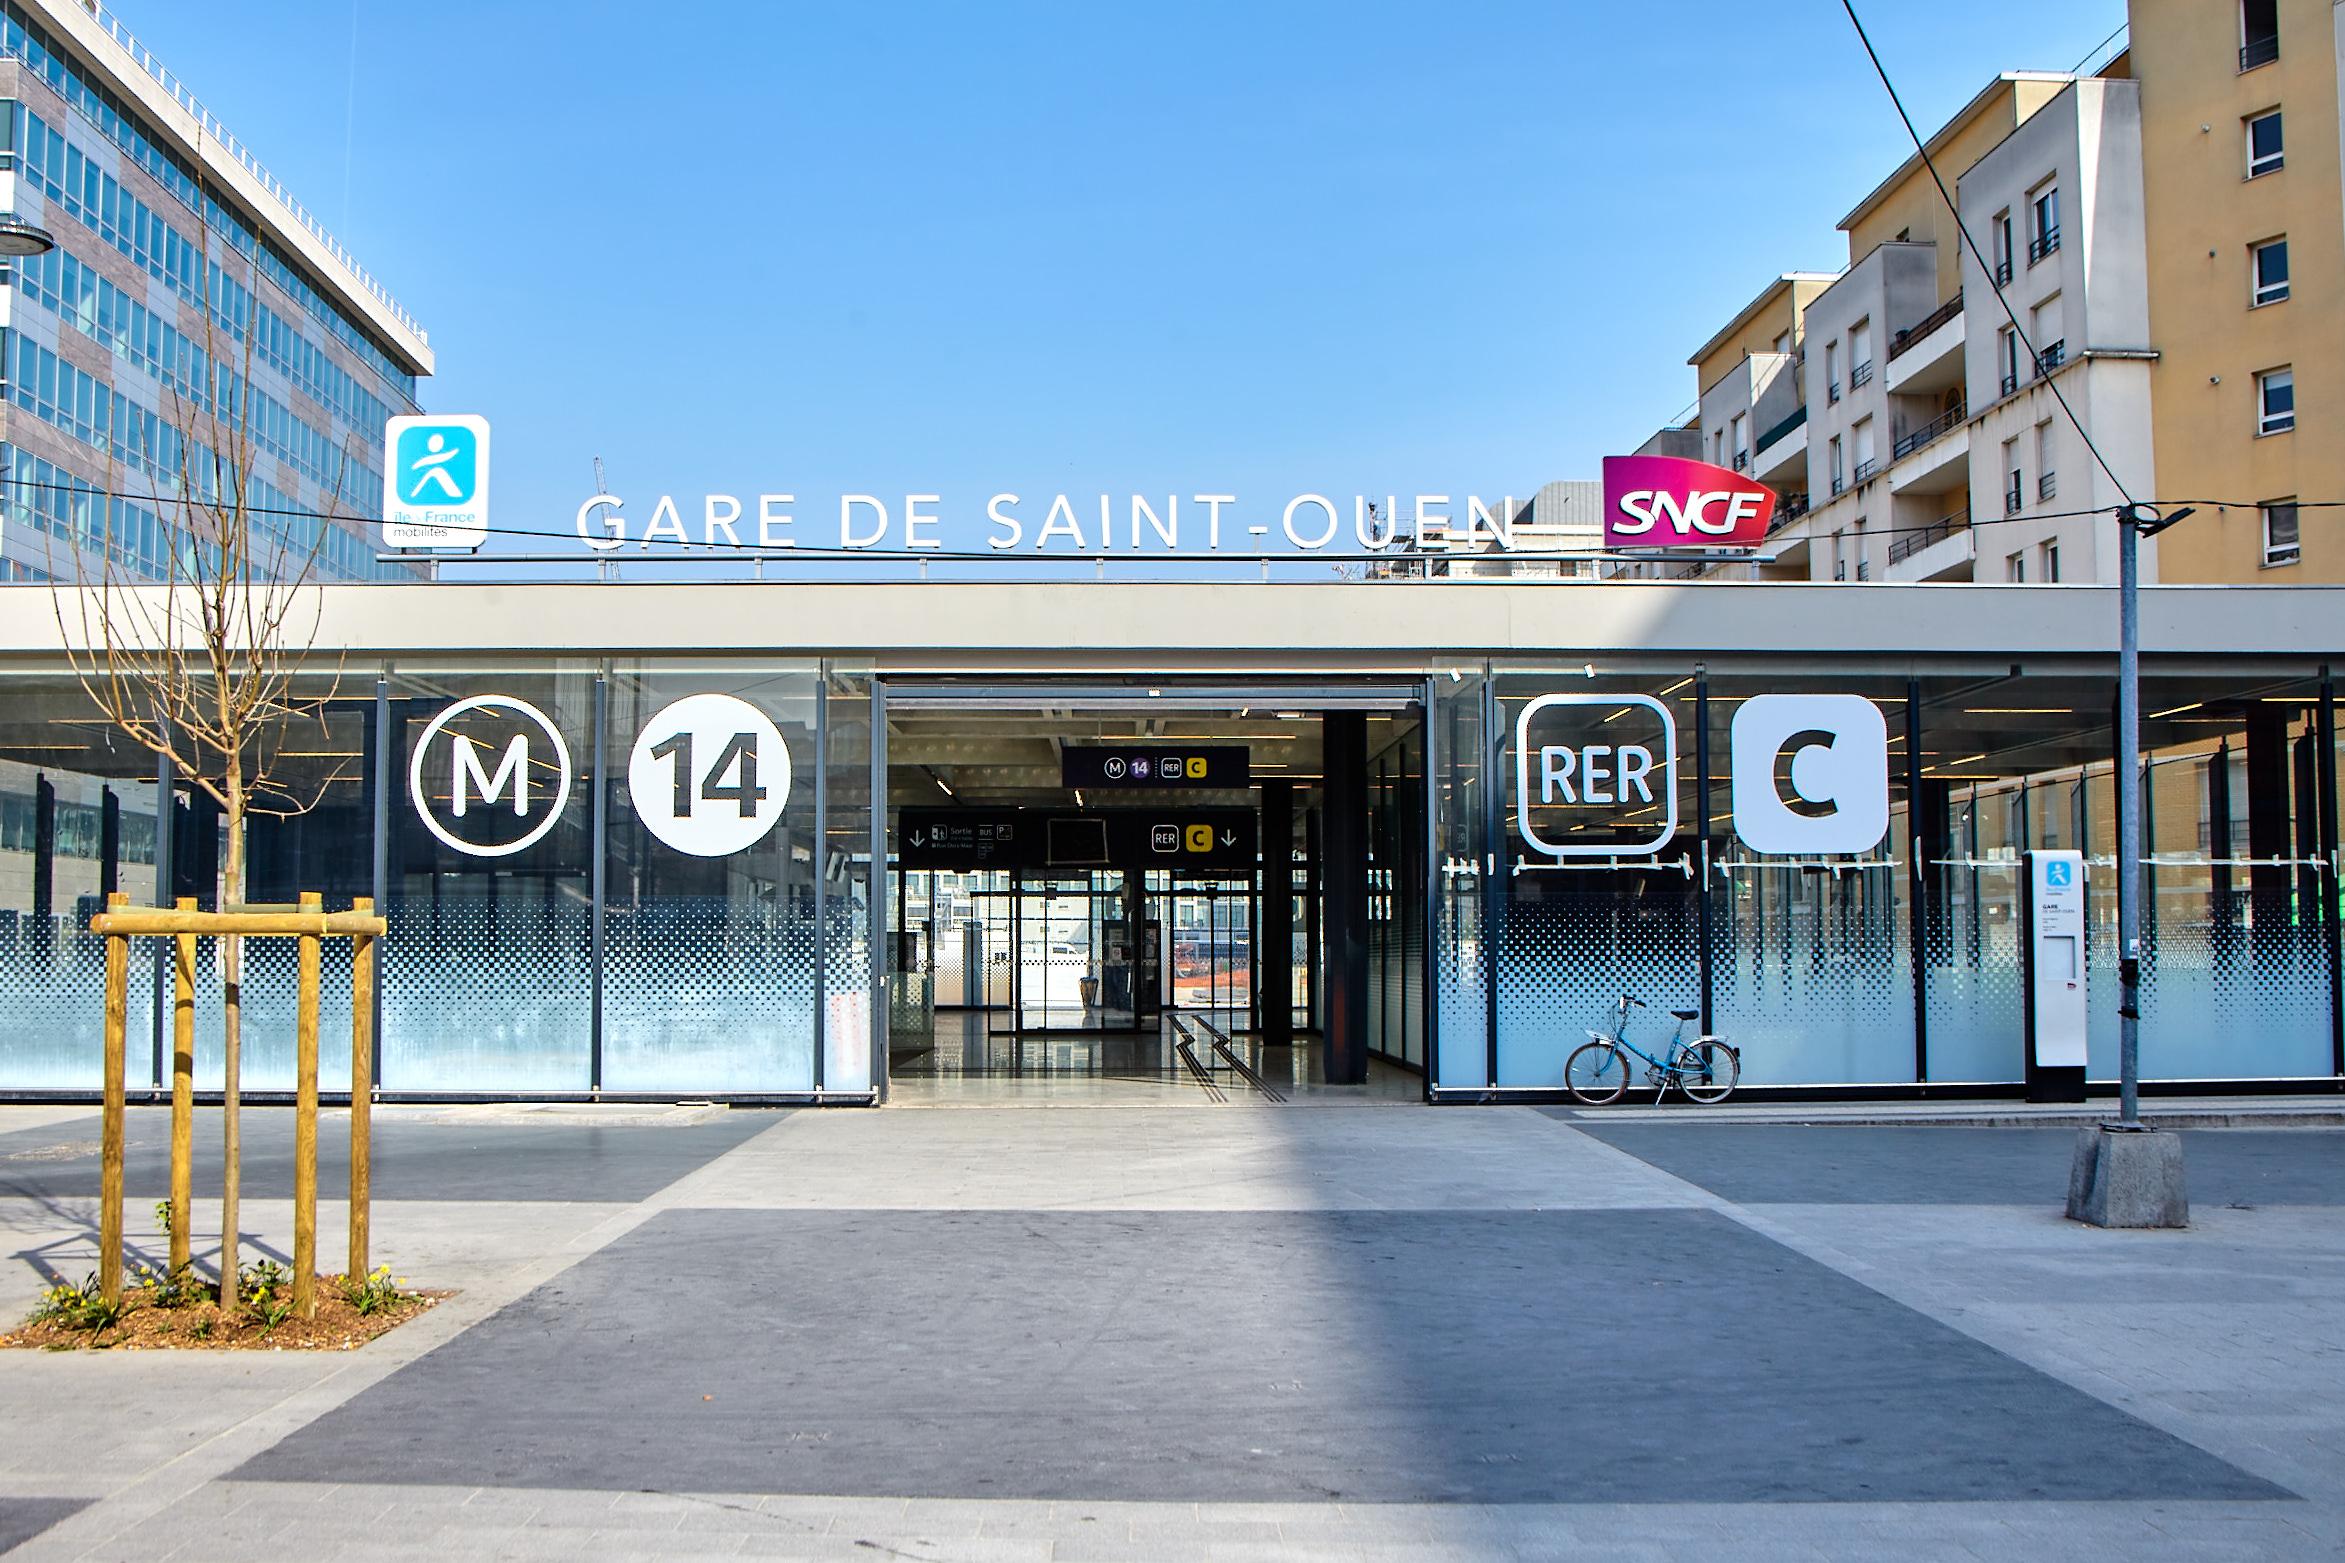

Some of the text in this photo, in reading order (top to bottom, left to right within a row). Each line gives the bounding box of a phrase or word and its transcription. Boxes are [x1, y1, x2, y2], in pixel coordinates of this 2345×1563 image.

[425, 511, 476, 523] France
[576, 494, 1515, 550] GARE DE SAINT-OUEN
[1611, 490, 1766, 536] SNCF
[453, 732, 768, 818] M 14
[1109, 761, 1201, 774] M 14 RER C
[1541, 729, 1838, 818] RER C
[1155, 830, 1205, 846] RER C
